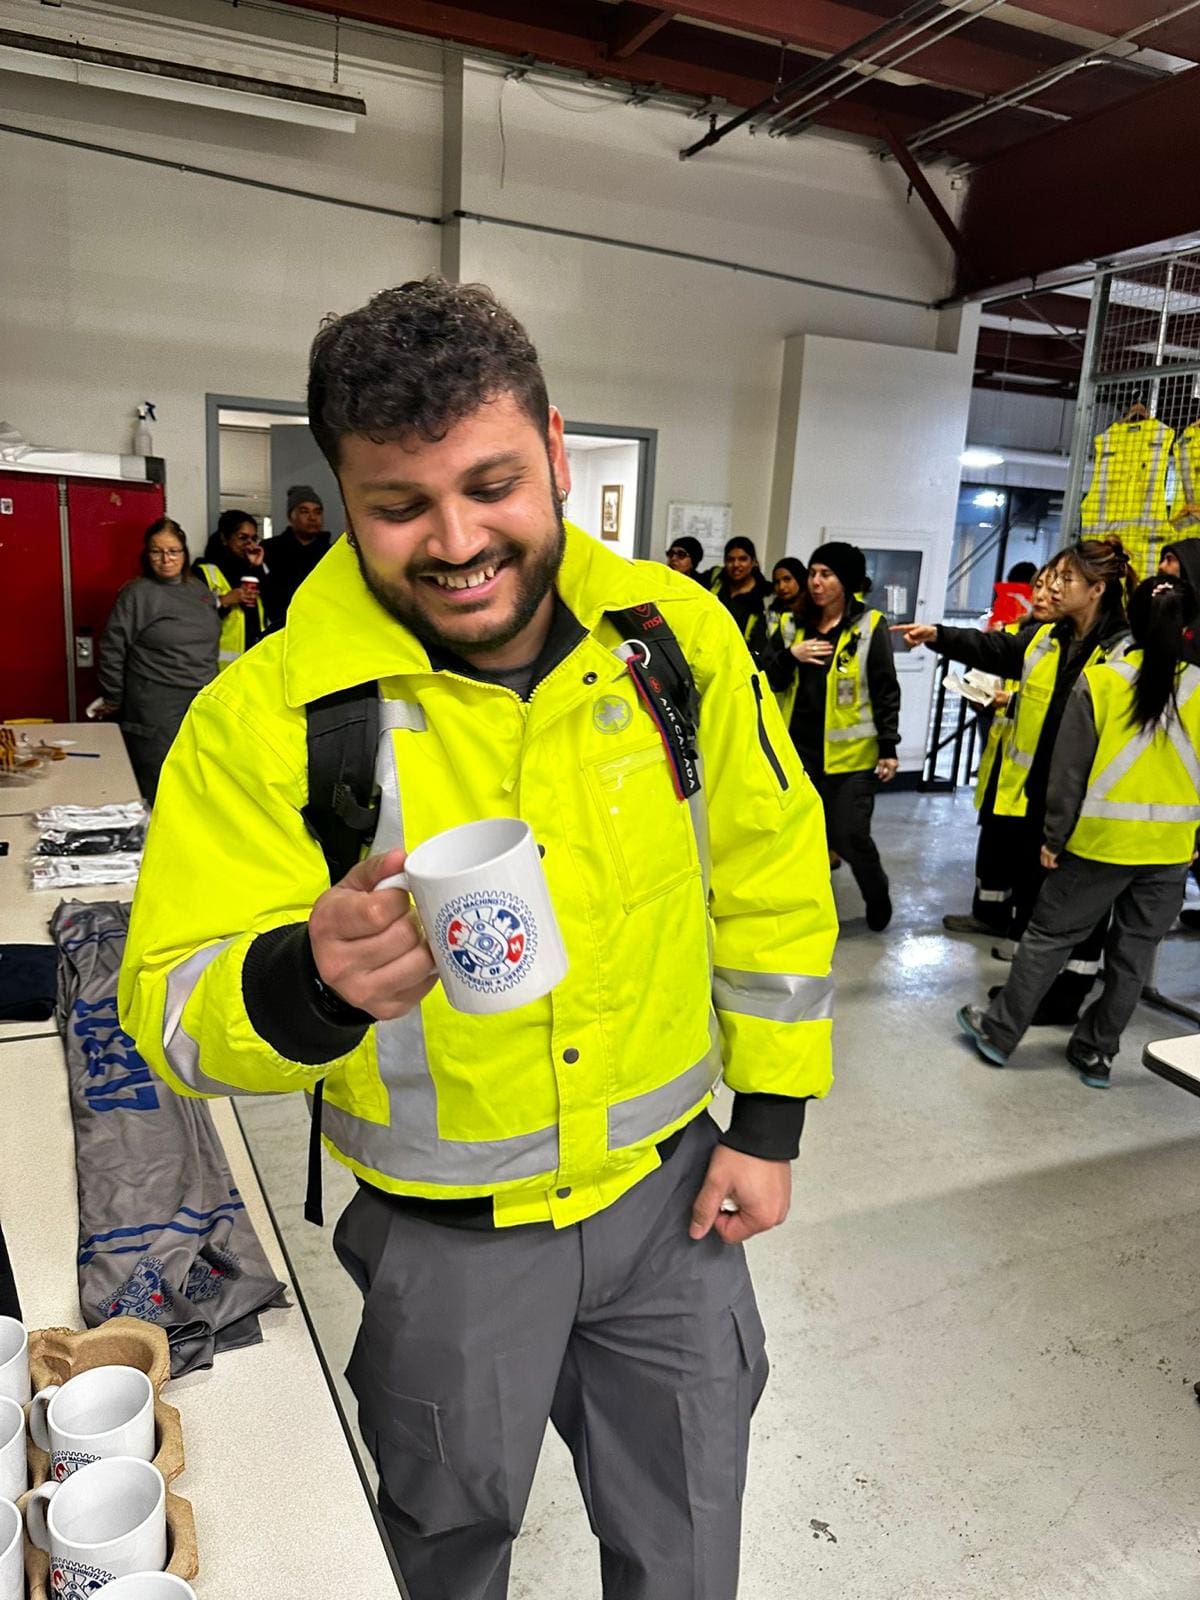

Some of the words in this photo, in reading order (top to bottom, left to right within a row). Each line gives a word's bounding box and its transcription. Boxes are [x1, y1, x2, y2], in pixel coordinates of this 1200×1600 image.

[643, 615, 663, 631] msi
[659, 697, 676, 722] AIR
[463, 898, 507, 909] MACHINISTS
[507, 902, 521, 914] AND
[489, 966, 501, 975] OF
[504, 955, 528, 981] WORKERS
